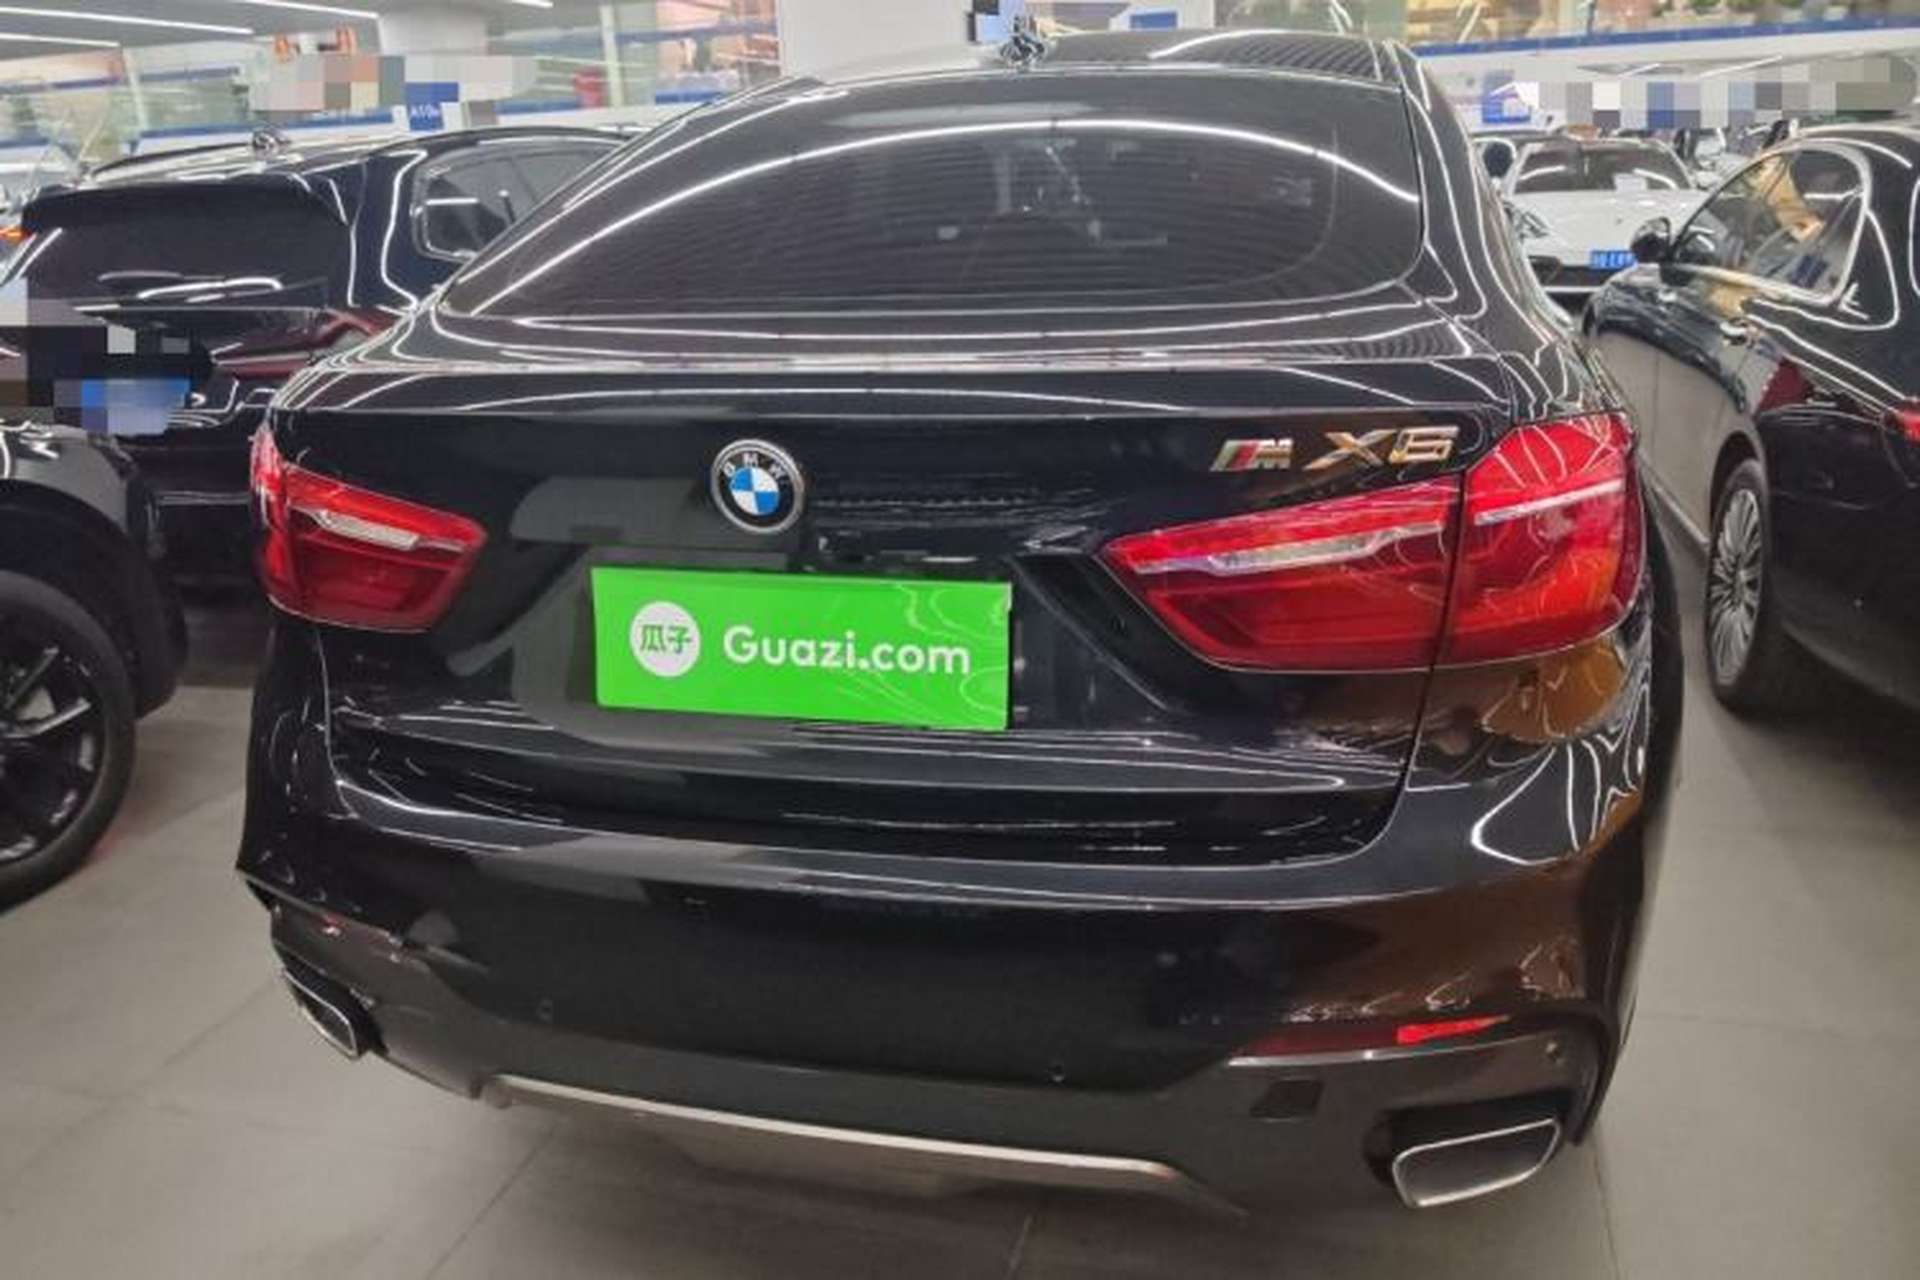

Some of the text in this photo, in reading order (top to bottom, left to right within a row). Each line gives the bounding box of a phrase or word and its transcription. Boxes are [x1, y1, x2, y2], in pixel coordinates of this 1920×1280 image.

[722, 451, 786, 480] BMW
[1302, 425, 1460, 471] X6
[639, 623, 692, 655] 瓜子
[722, 624, 972, 675] Guazi.com
